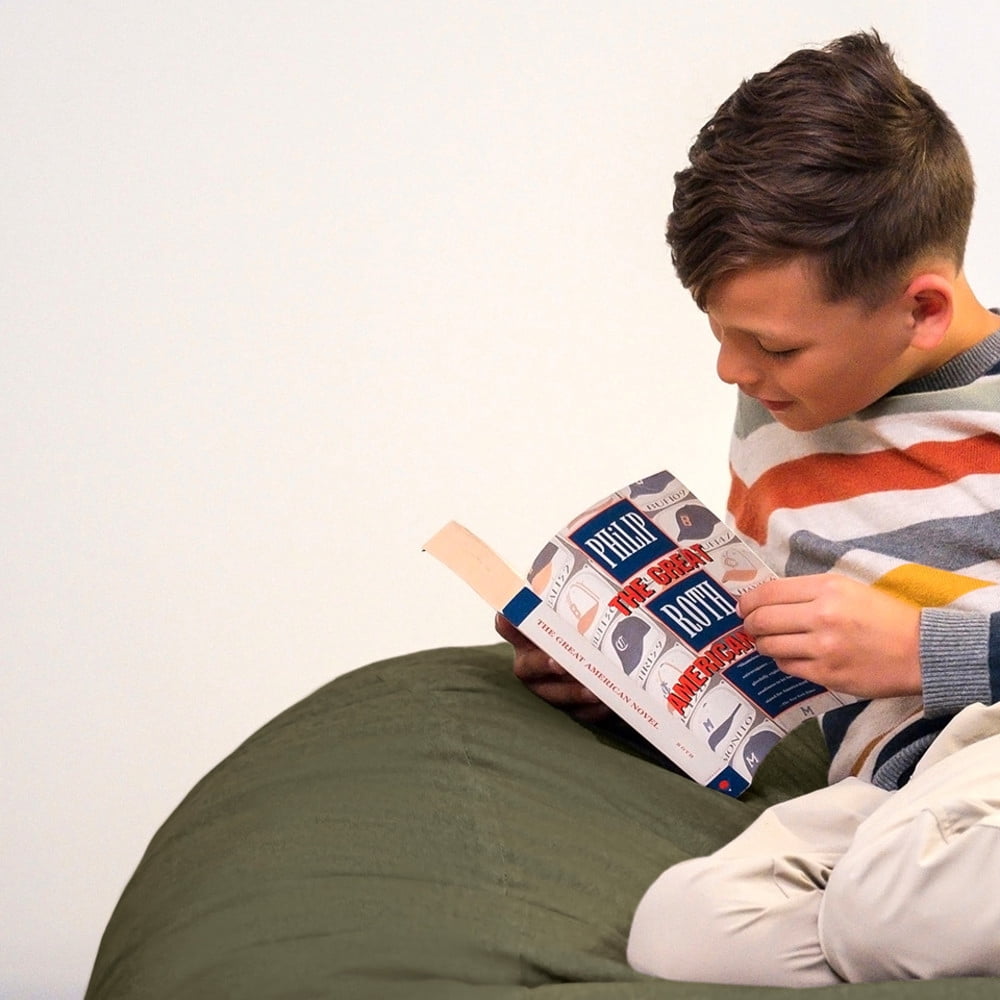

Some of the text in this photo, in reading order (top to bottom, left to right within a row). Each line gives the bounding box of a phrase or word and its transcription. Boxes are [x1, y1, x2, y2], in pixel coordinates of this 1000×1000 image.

[608, 577, 656, 617] THE
[647, 543, 714, 586] GREAT
[660, 580, 737, 639] ROTH
[537, 618, 556, 638] THE
[555, 634, 586, 664] GREAT
[584, 662, 633, 703] AMERICAN
[630, 701, 660, 730] NOVEL
[666, 629, 757, 716] AMERICAN
